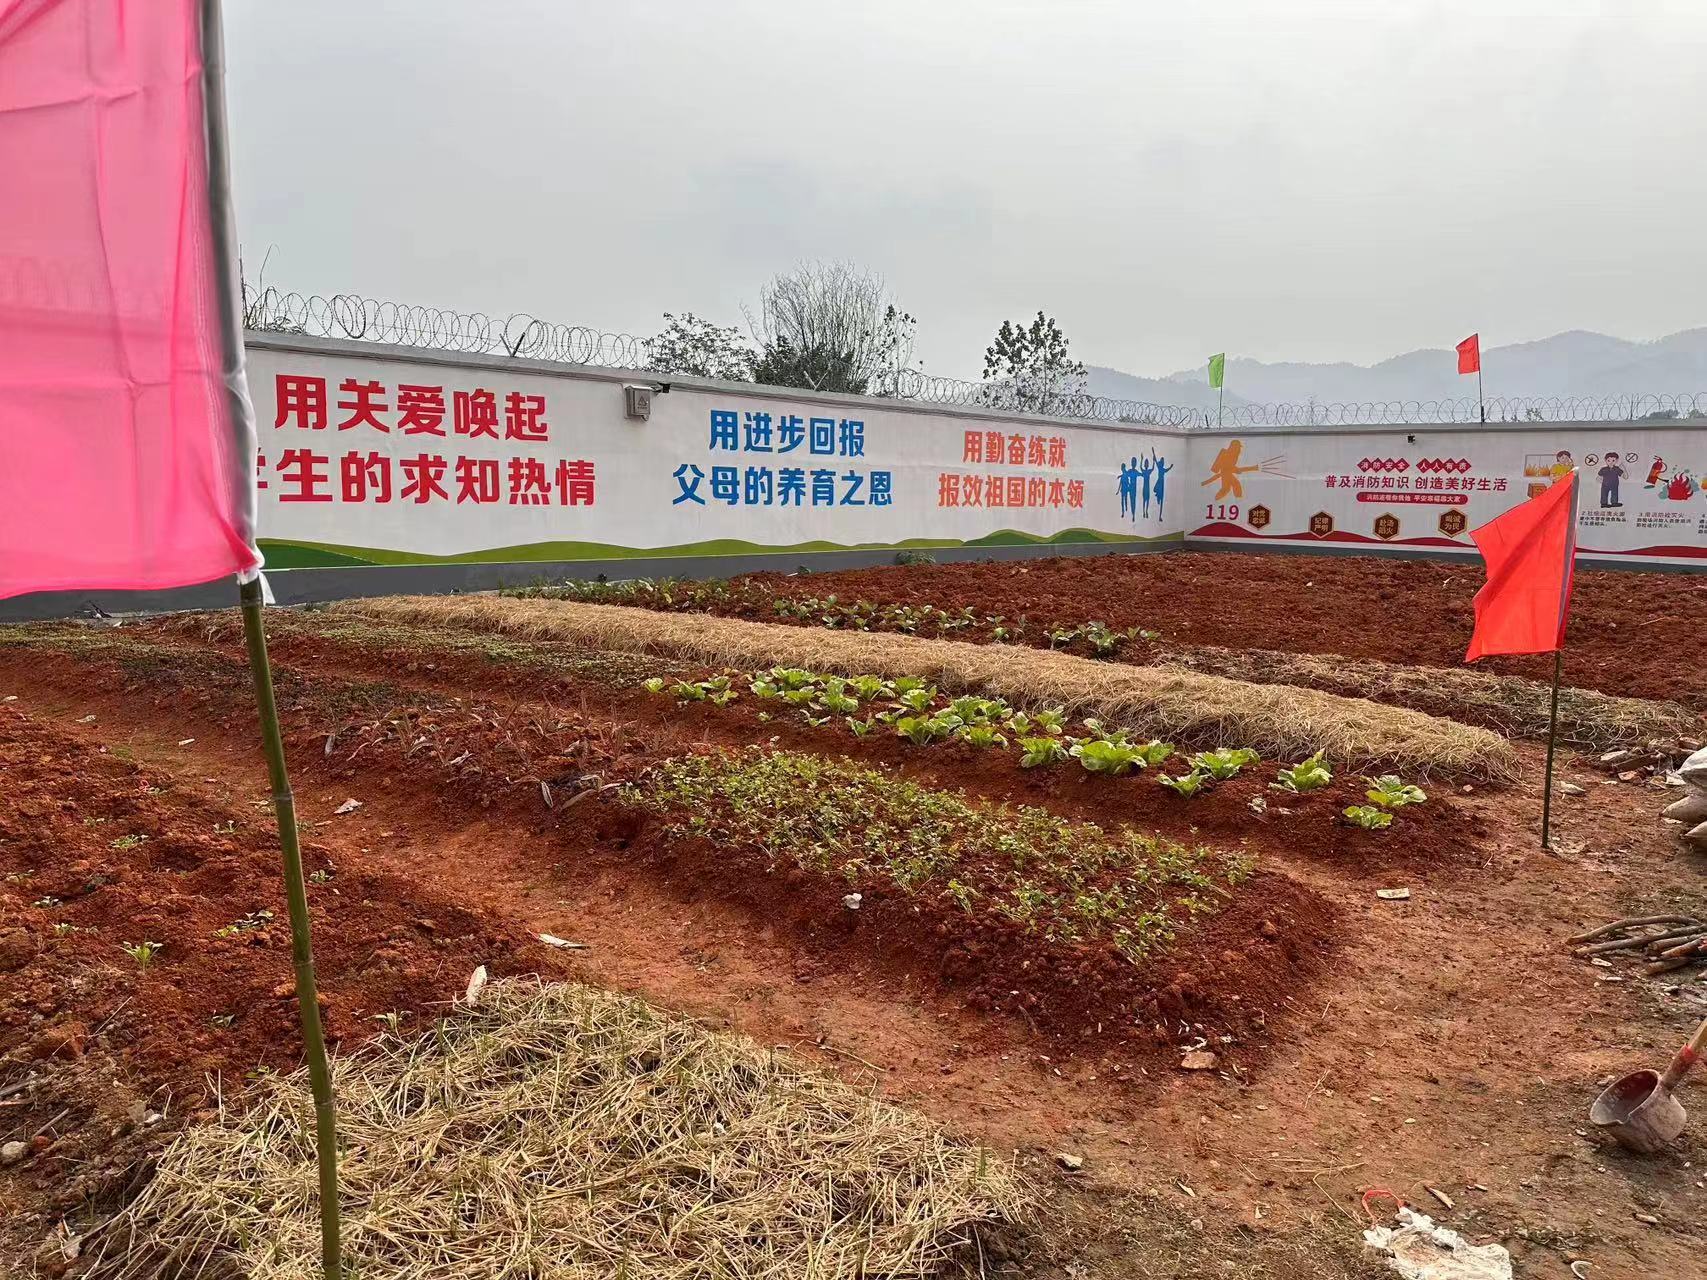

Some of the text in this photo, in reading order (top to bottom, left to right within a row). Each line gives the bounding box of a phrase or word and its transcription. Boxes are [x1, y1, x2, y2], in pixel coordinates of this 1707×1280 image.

[274, 374, 549, 442] 用关爱唤起
[708, 409, 865, 458] 用进步回报
[962, 430, 1067, 468] 用勤奋练就
[257, 447, 596, 506] 生的求知热情
[672, 463, 893, 507] 父母的养育之恩
[1324, 475, 1508, 491] 普及消防知识 创造美好生活
[1359, 461, 1467, 471] 消防安全 人人有责
[938, 473, 1085, 509] 报效祖国的本领
[1205, 504, 1239, 520] 119
